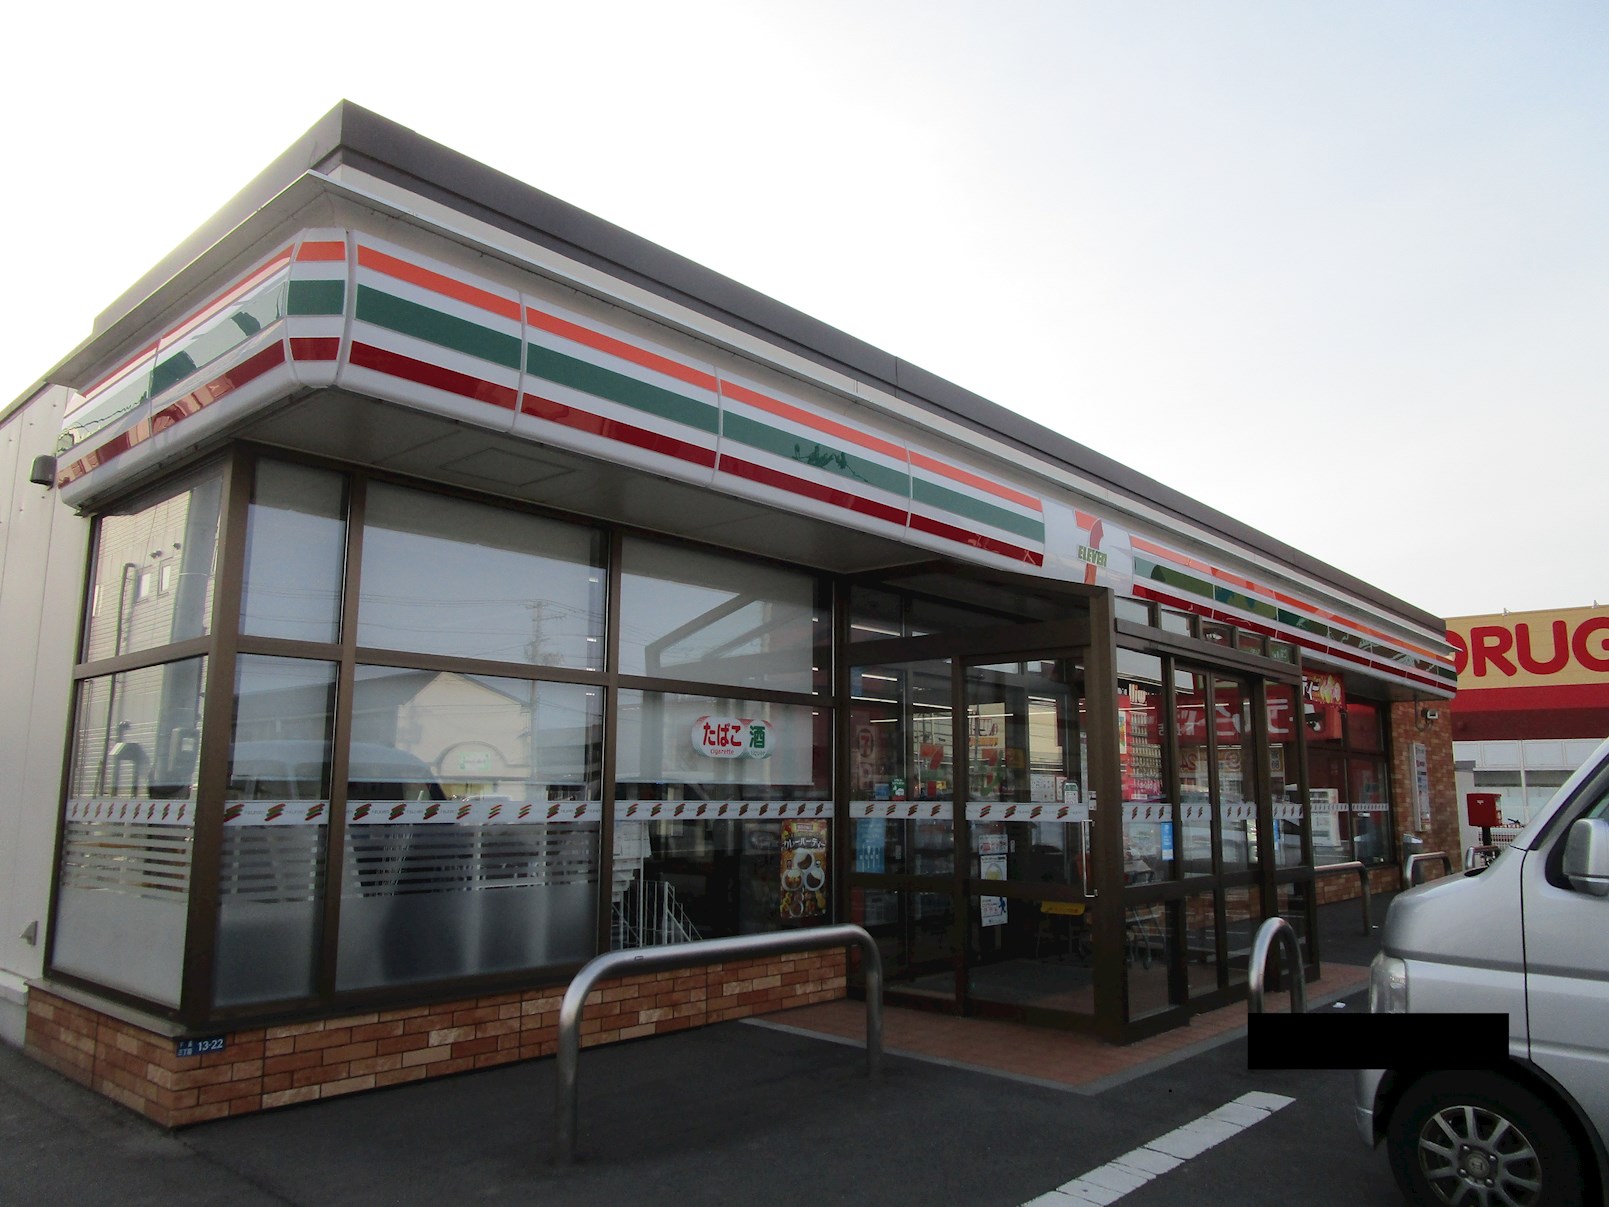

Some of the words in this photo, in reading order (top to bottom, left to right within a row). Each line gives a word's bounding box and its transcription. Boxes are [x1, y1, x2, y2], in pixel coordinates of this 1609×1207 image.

[703, 722, 742, 747] たばこ
[749, 725, 766, 748] 酒
[198, 1038, 224, 1051] 13-22
